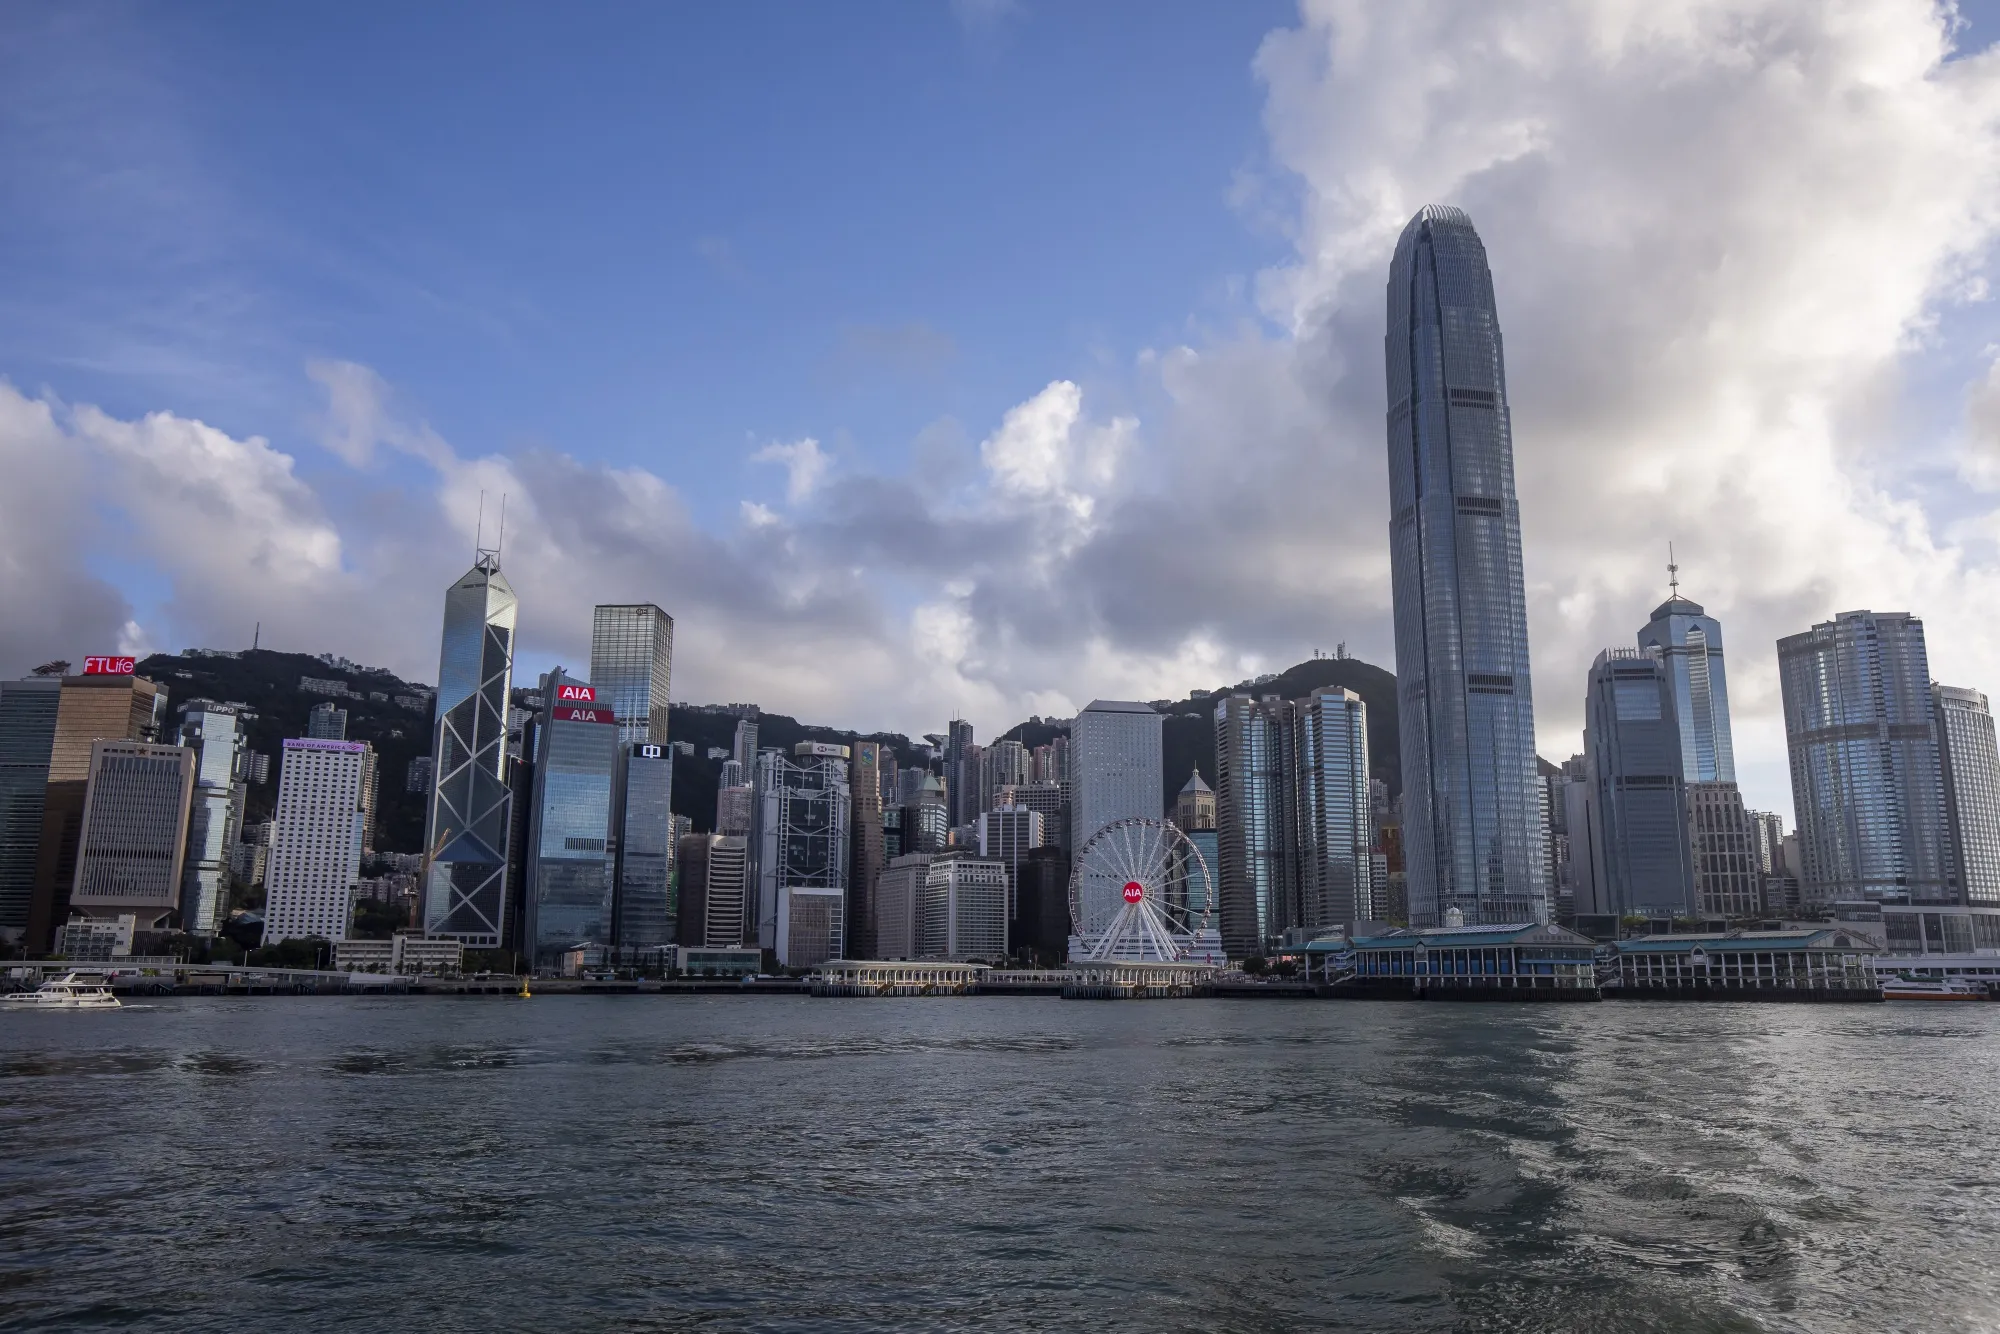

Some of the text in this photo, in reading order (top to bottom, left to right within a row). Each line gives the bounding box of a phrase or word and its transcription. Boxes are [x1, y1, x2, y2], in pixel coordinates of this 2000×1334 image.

[84, 657, 133, 673] FTLife
[562, 687, 592, 700] AIA
[207, 704, 235, 714] LIPPO
[570, 709, 597, 722] AIA
[1124, 888, 1142, 897] AIA
